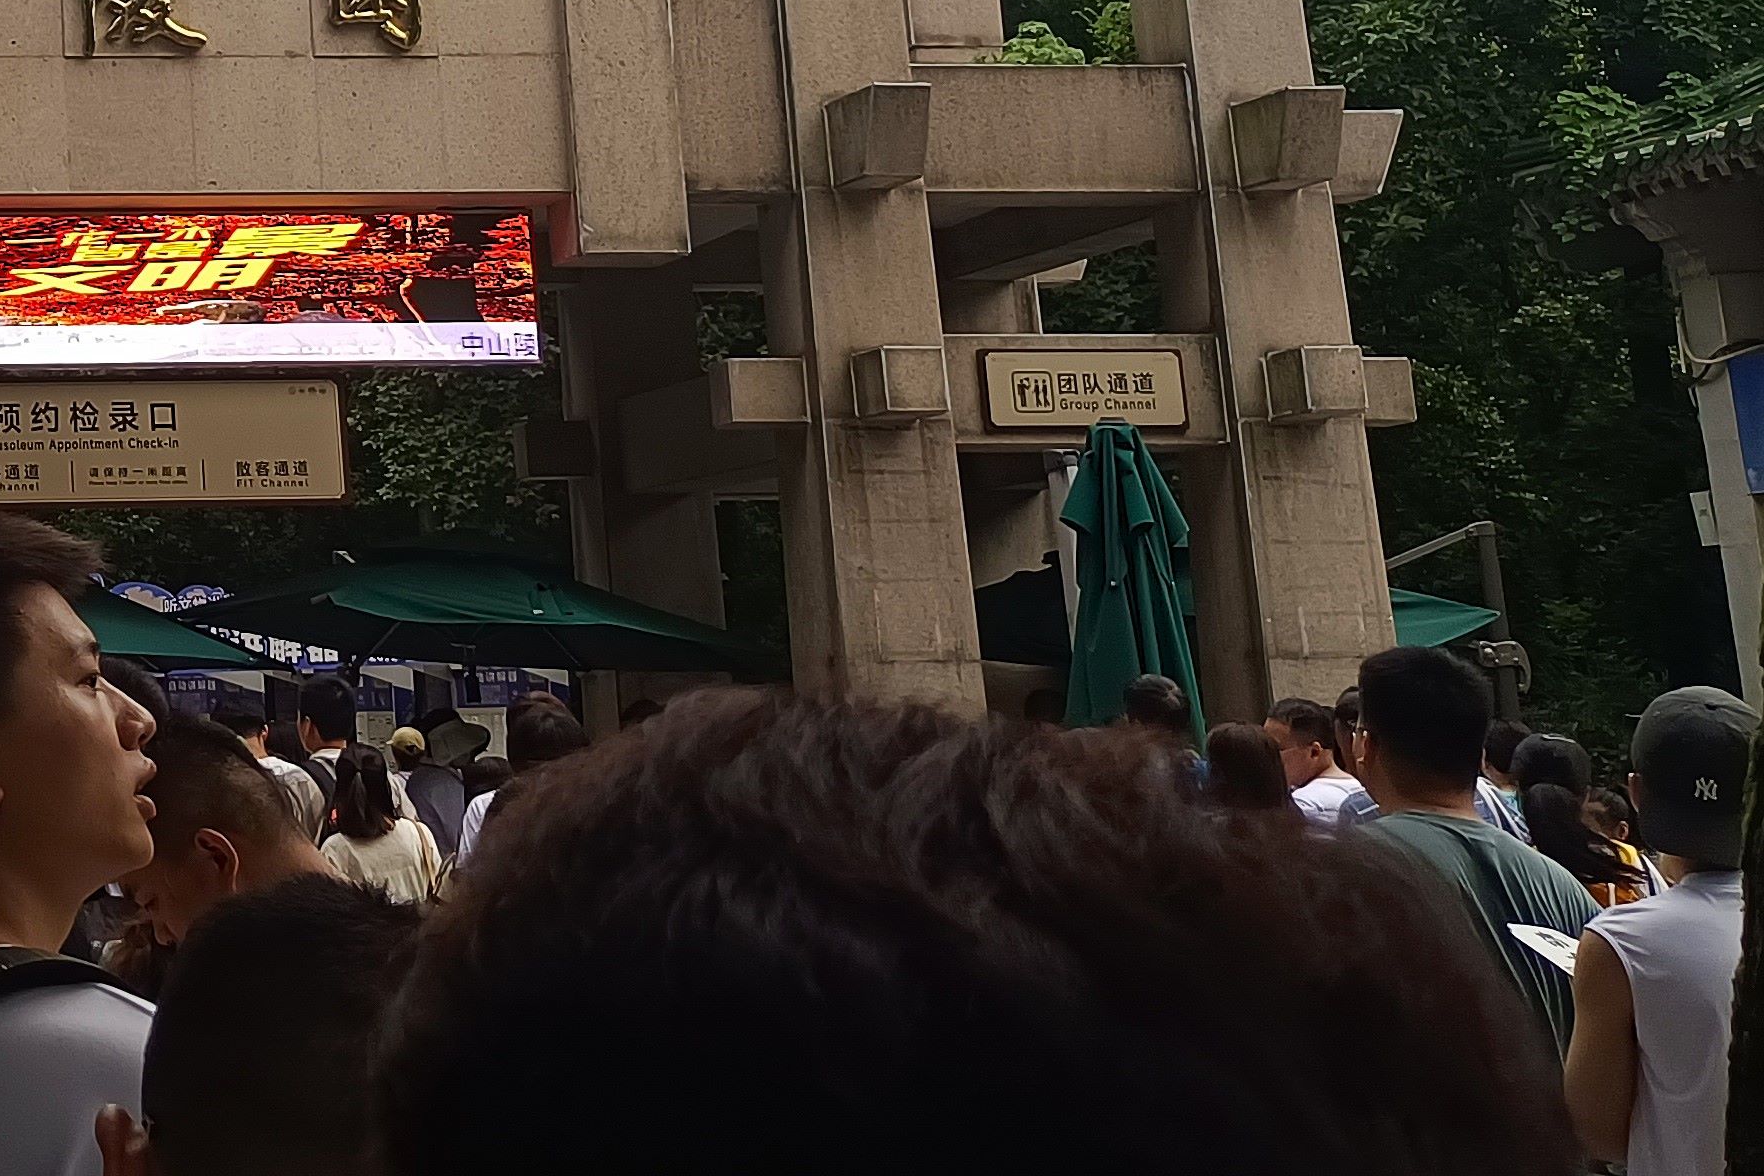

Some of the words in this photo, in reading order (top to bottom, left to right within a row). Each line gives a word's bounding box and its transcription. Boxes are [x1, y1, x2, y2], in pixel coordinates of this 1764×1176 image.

[1057, 372, 1156, 395] 团队通道
[1059, 397, 1100, 411] Group
[1104, 397, 1157, 410] Channel
[48, 437, 124, 452] Appointment
[236, 460, 309, 477] 散客通道
[236, 478, 255, 488] FIT
[260, 478, 309, 488] Channel
[1694, 777, 1718, 801] NY
